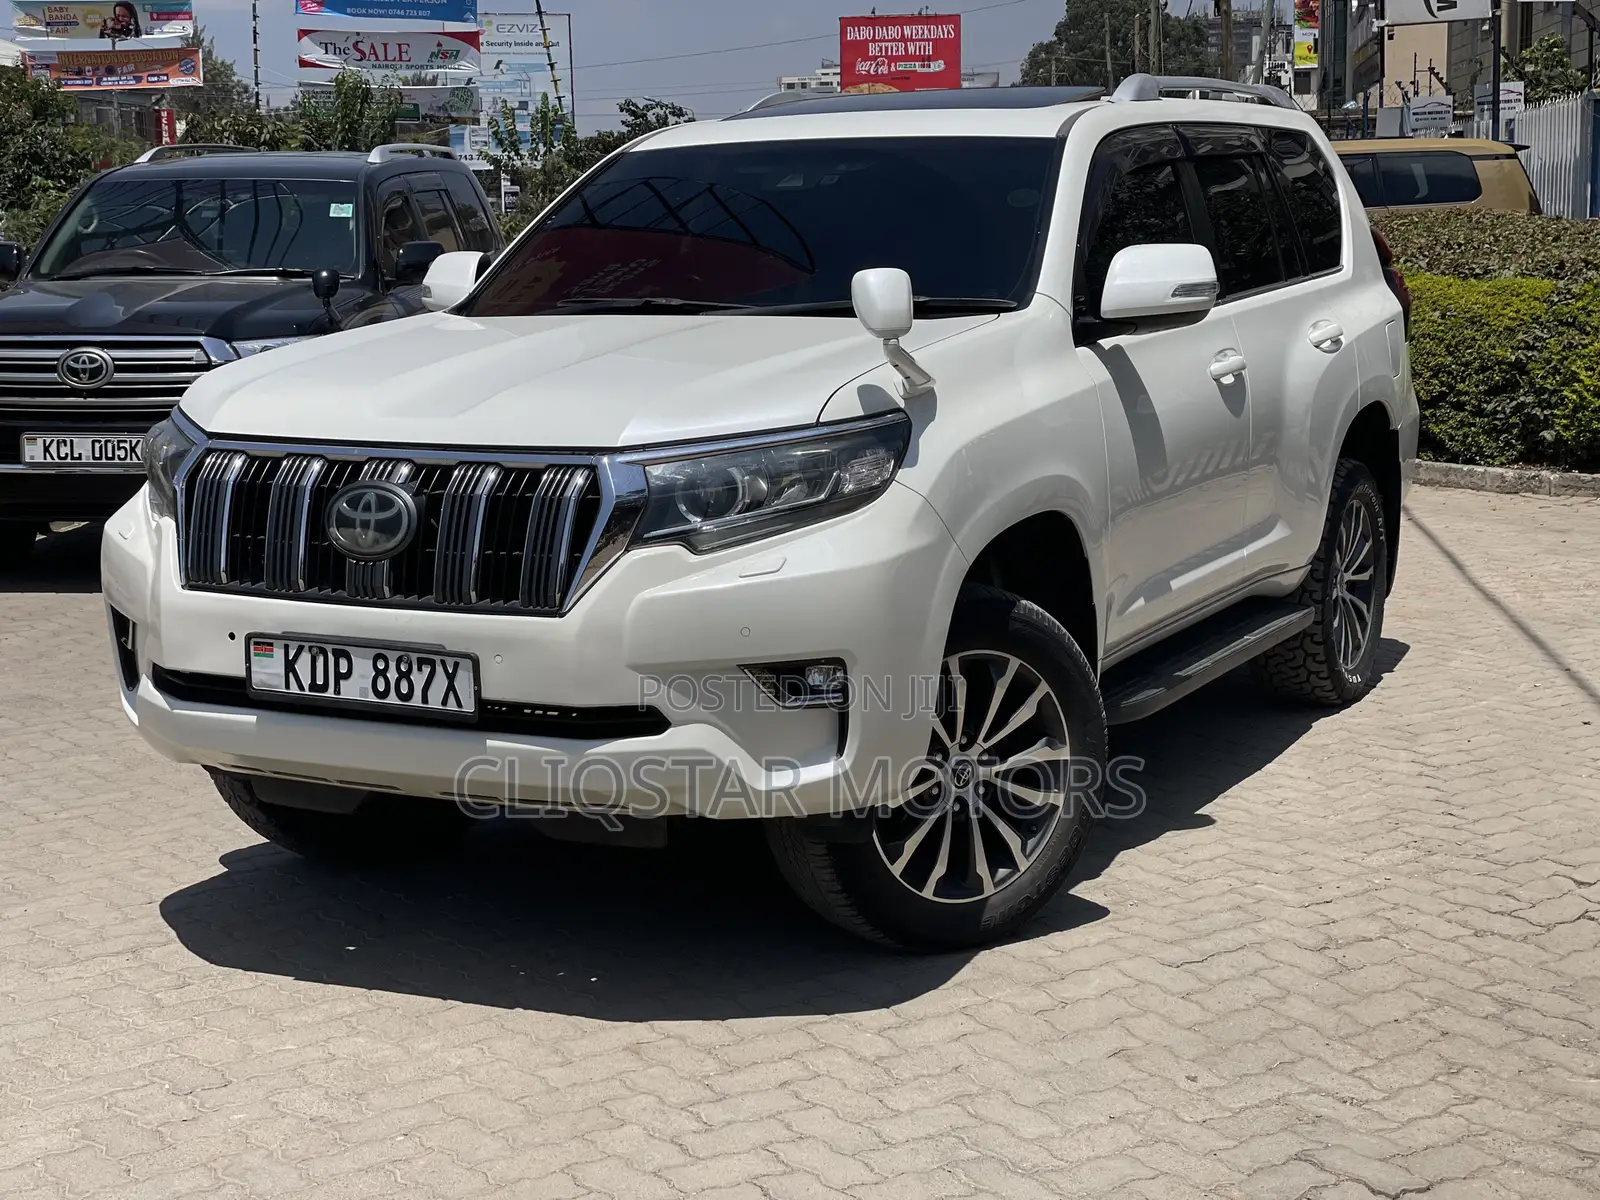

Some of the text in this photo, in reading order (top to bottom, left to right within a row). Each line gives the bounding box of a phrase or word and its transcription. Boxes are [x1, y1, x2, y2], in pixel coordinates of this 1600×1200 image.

[496, 23, 539, 33] EZVIZ
[846, 24, 955, 41] DABO DABO WEEKDAYS
[319, 39, 412, 62] The SALE
[485, 40, 512, 48] Security
[868, 41, 933, 56] BETTER WITH
[58, 52, 128, 66] INTERNATIONAL
[130, 51, 180, 63] EDUCATION
[117, 63, 136, 75] FAIR
[43, 438, 142, 461] KCL 005K
[283, 643, 464, 709] KDP 887X
